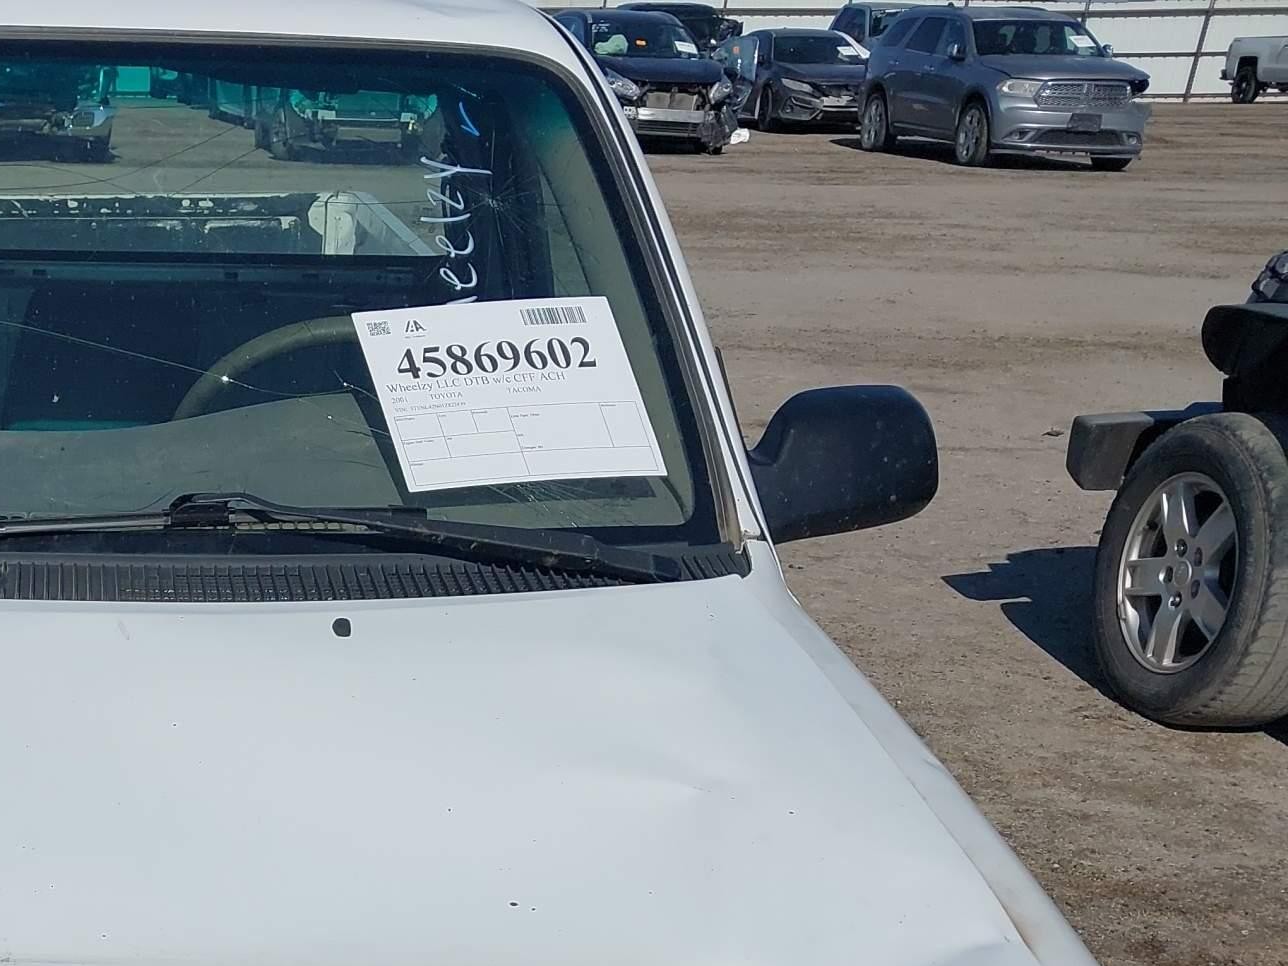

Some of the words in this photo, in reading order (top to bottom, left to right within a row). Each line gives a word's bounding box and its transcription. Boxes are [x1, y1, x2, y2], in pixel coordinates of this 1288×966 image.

[397, 336, 596, 379] 45869602
[386, 381, 432, 393] Wheelzy
[436, 378, 461, 389] LLC
[463, 375, 490, 387] DTB
[513, 372, 535, 383] CFF
[540, 371, 566, 382] ACH
[430, 391, 463, 400] TOYOTA
[507, 385, 542, 393] TACOMA
